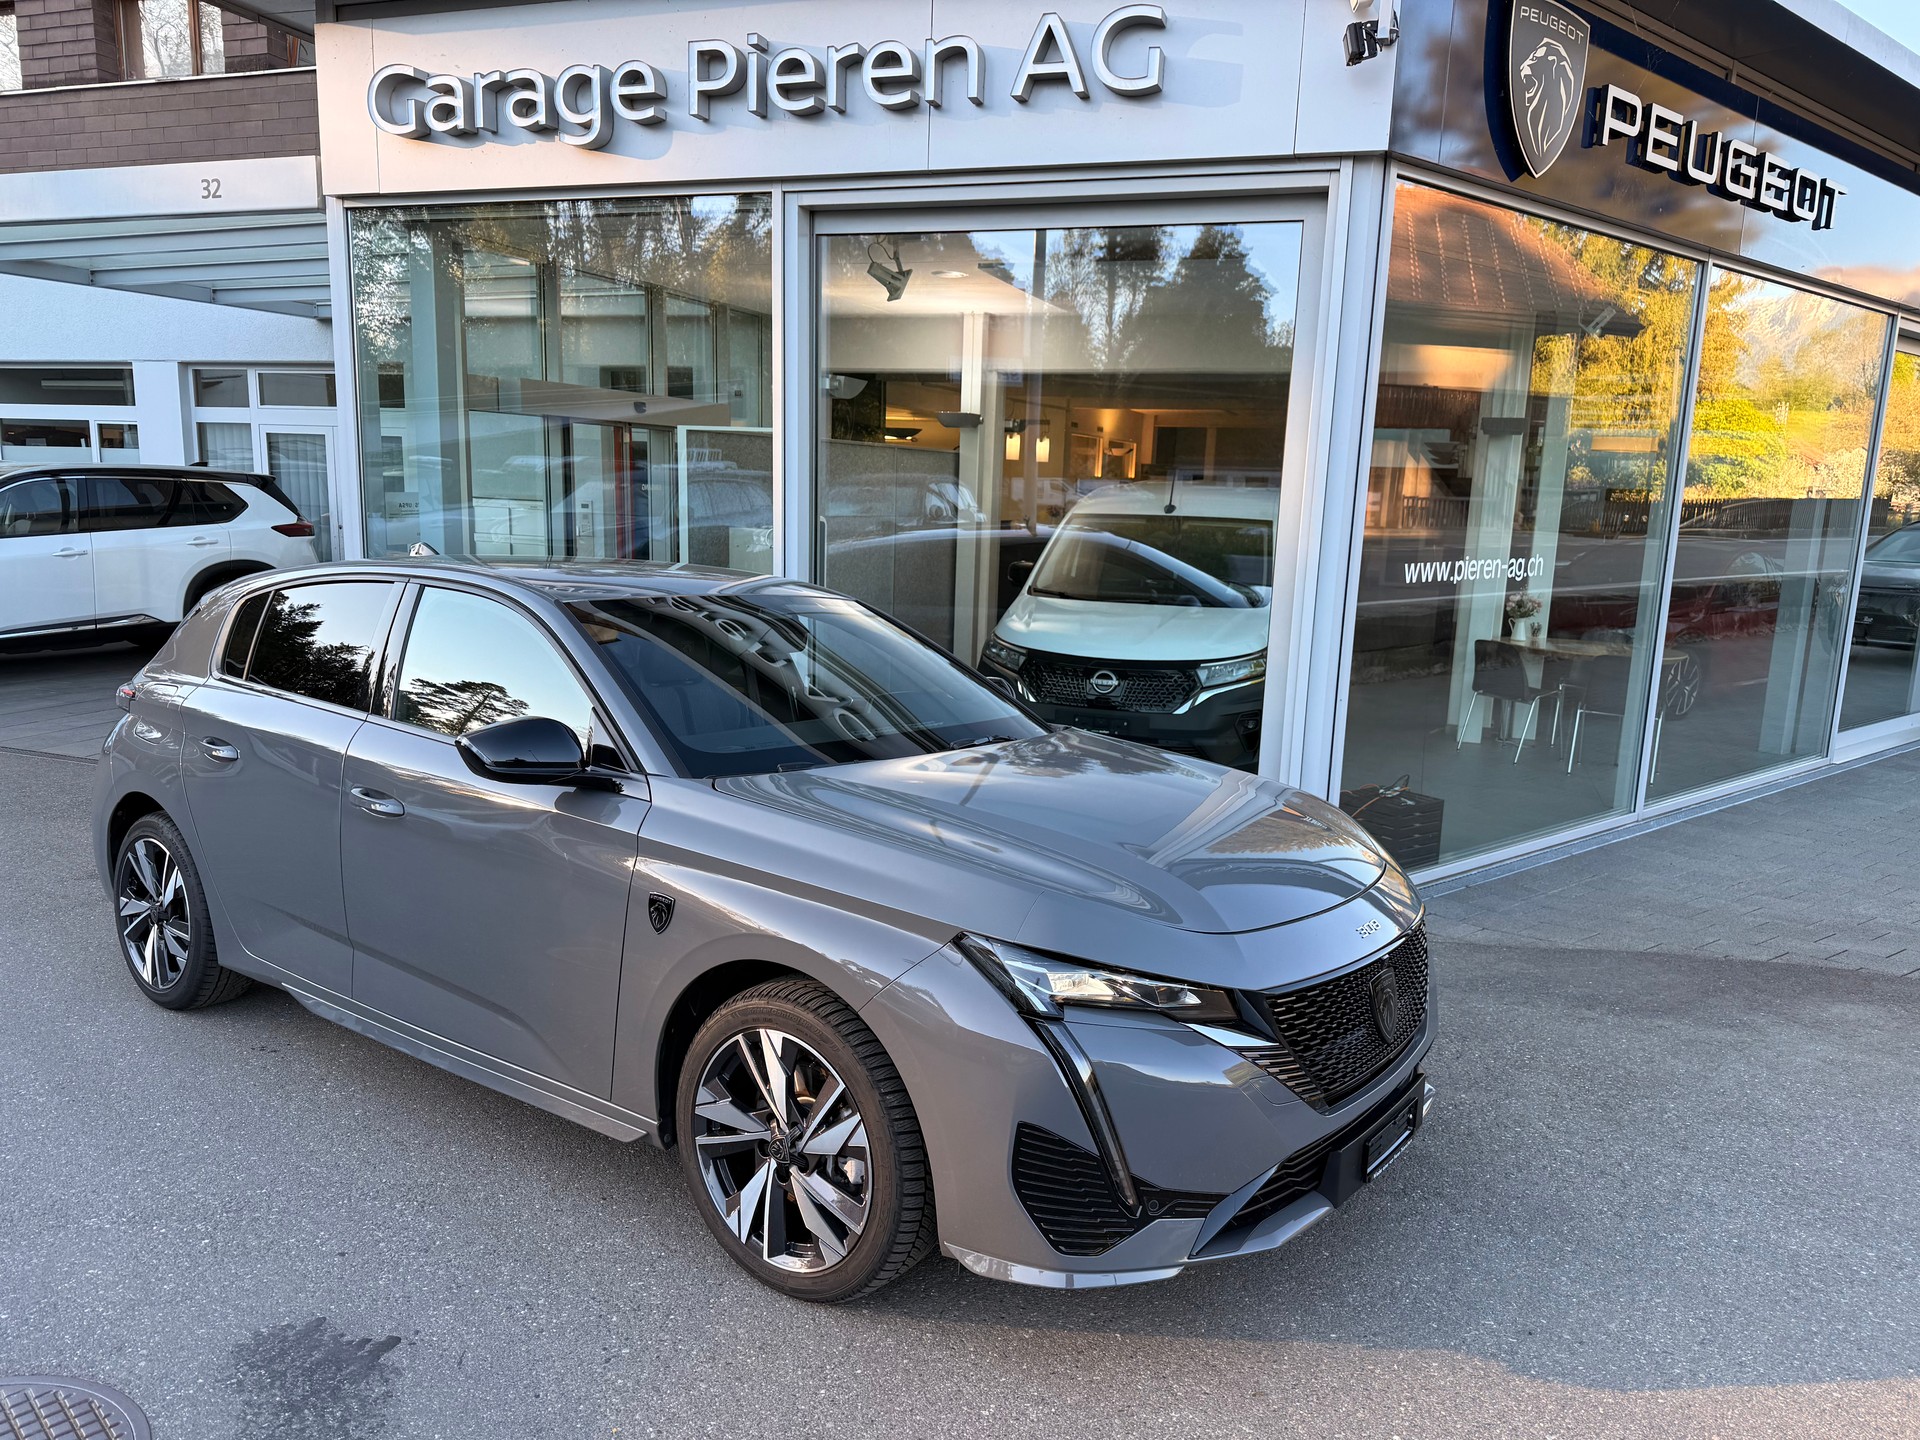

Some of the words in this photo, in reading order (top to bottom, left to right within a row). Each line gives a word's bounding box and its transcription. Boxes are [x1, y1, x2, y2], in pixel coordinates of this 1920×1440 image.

[1519, 5, 1585, 46] PEUGEOT
[366, 60, 667, 150] Garage
[688, 32, 984, 122] Pieren
[1009, 3, 1166, 104] AG
[1599, 83, 1848, 231] PEUGEOT
[200, 178, 222, 199] 32
[1404, 553, 1544, 584] www.pieren-ag.ch
[1355, 919, 1381, 938] 308
